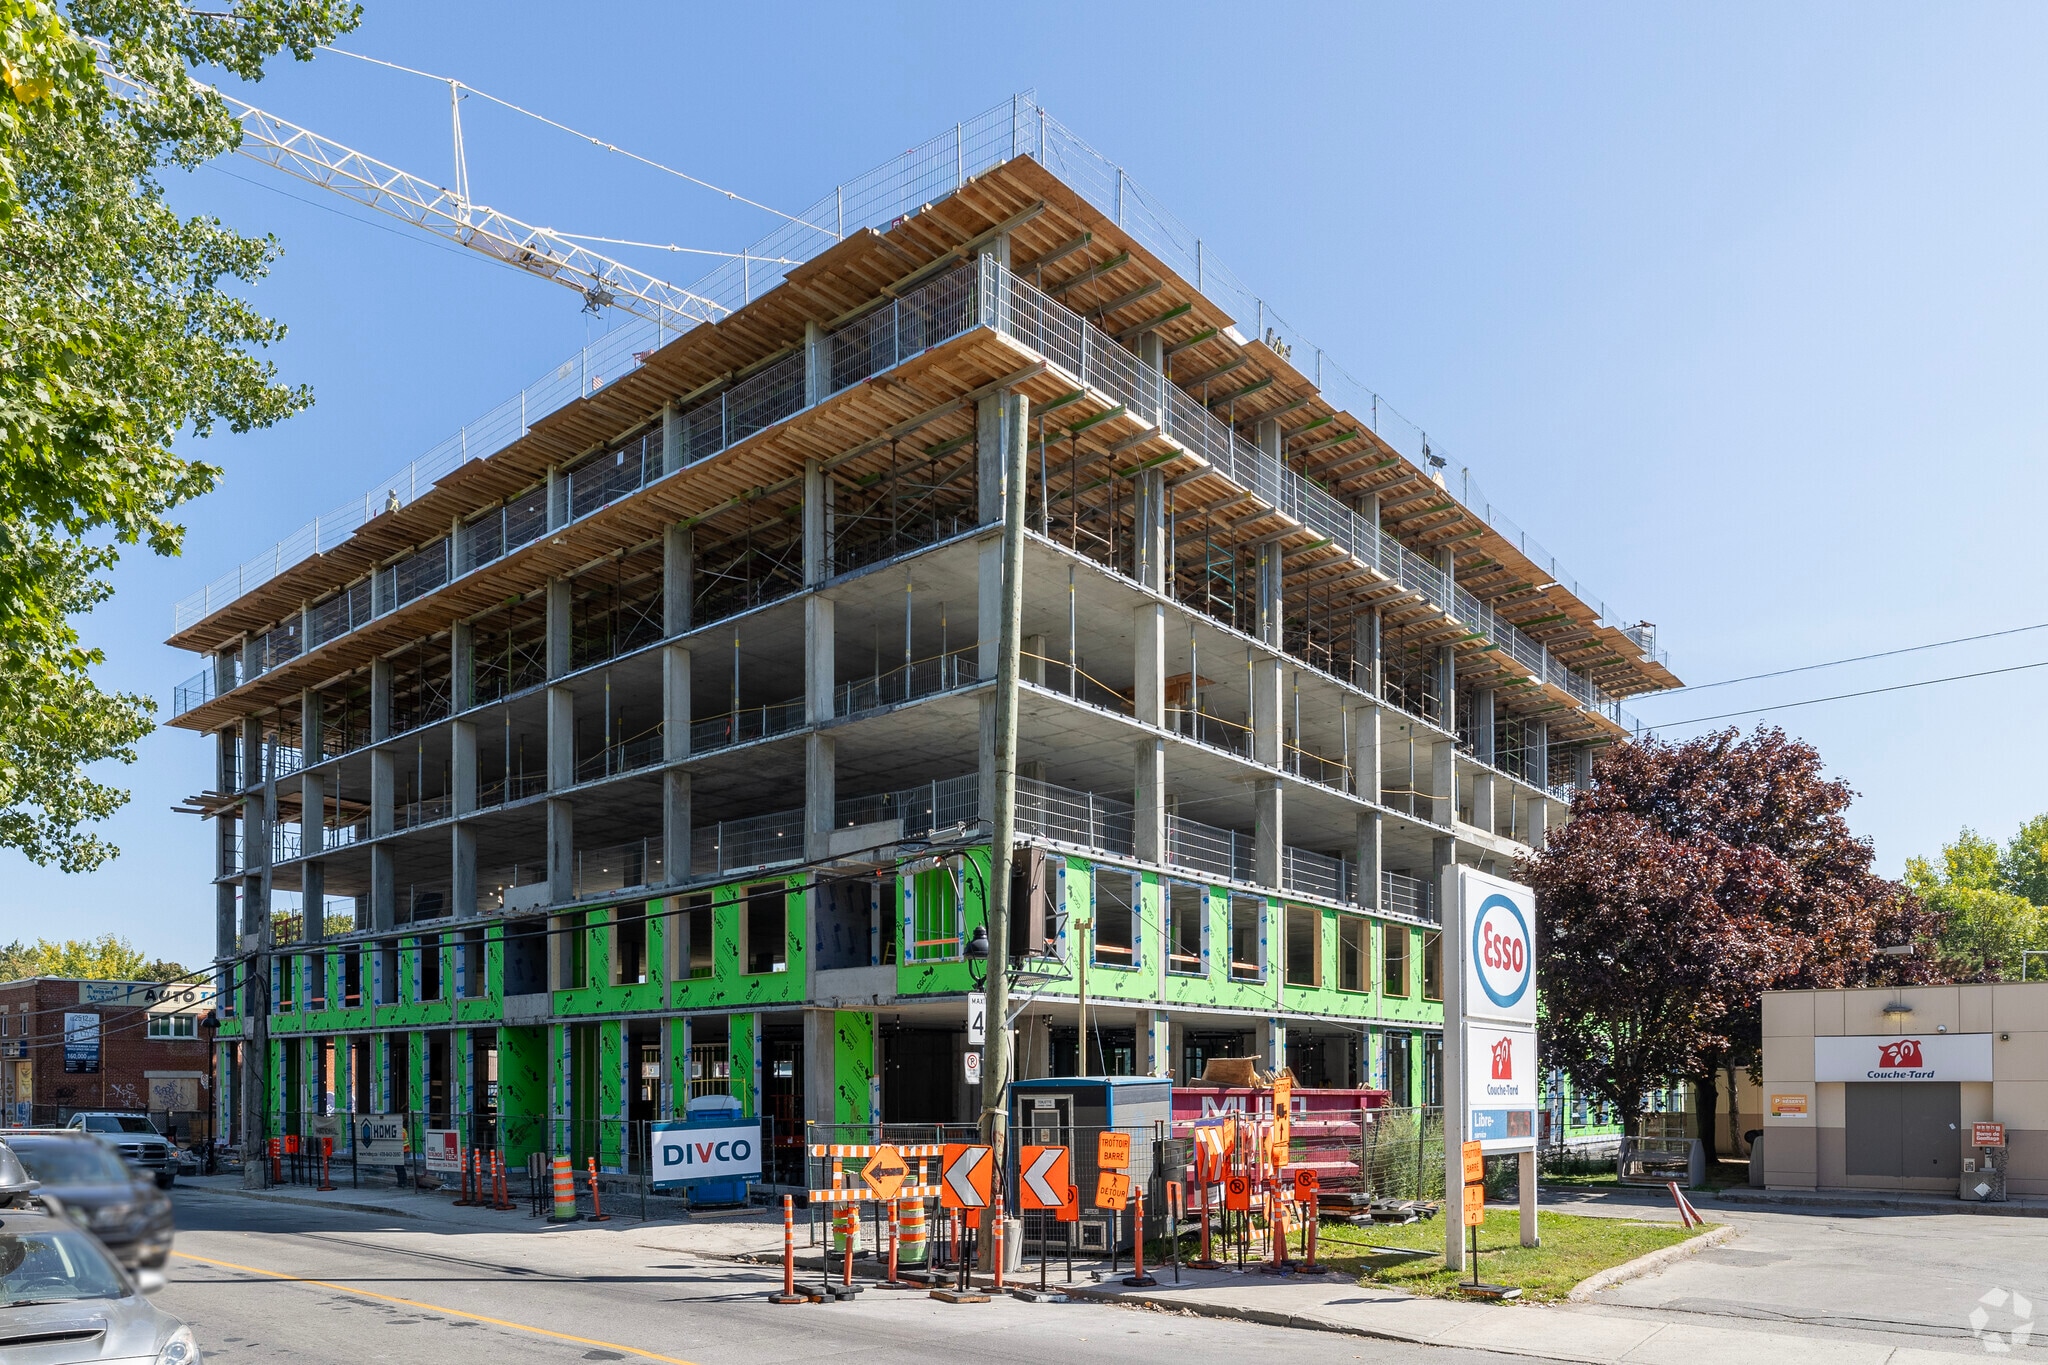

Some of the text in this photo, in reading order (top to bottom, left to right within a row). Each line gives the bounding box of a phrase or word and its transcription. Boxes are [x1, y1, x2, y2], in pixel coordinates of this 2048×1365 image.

[917, 976, 927, 990] CGC
[143, 989, 196, 1003] AUTO
[972, 1010, 984, 1036] 4
[1867, 1069, 1935, 1079] Couche-Tard
[1486, 1083, 1519, 1096] Couche-Tard
[1474, 1112, 1495, 1127] Libre-
[373, 1124, 398, 1139] HDMG
[1101, 1138, 1128, 1148] TROTTOIR
[663, 1139, 751, 1167] DIVCO
